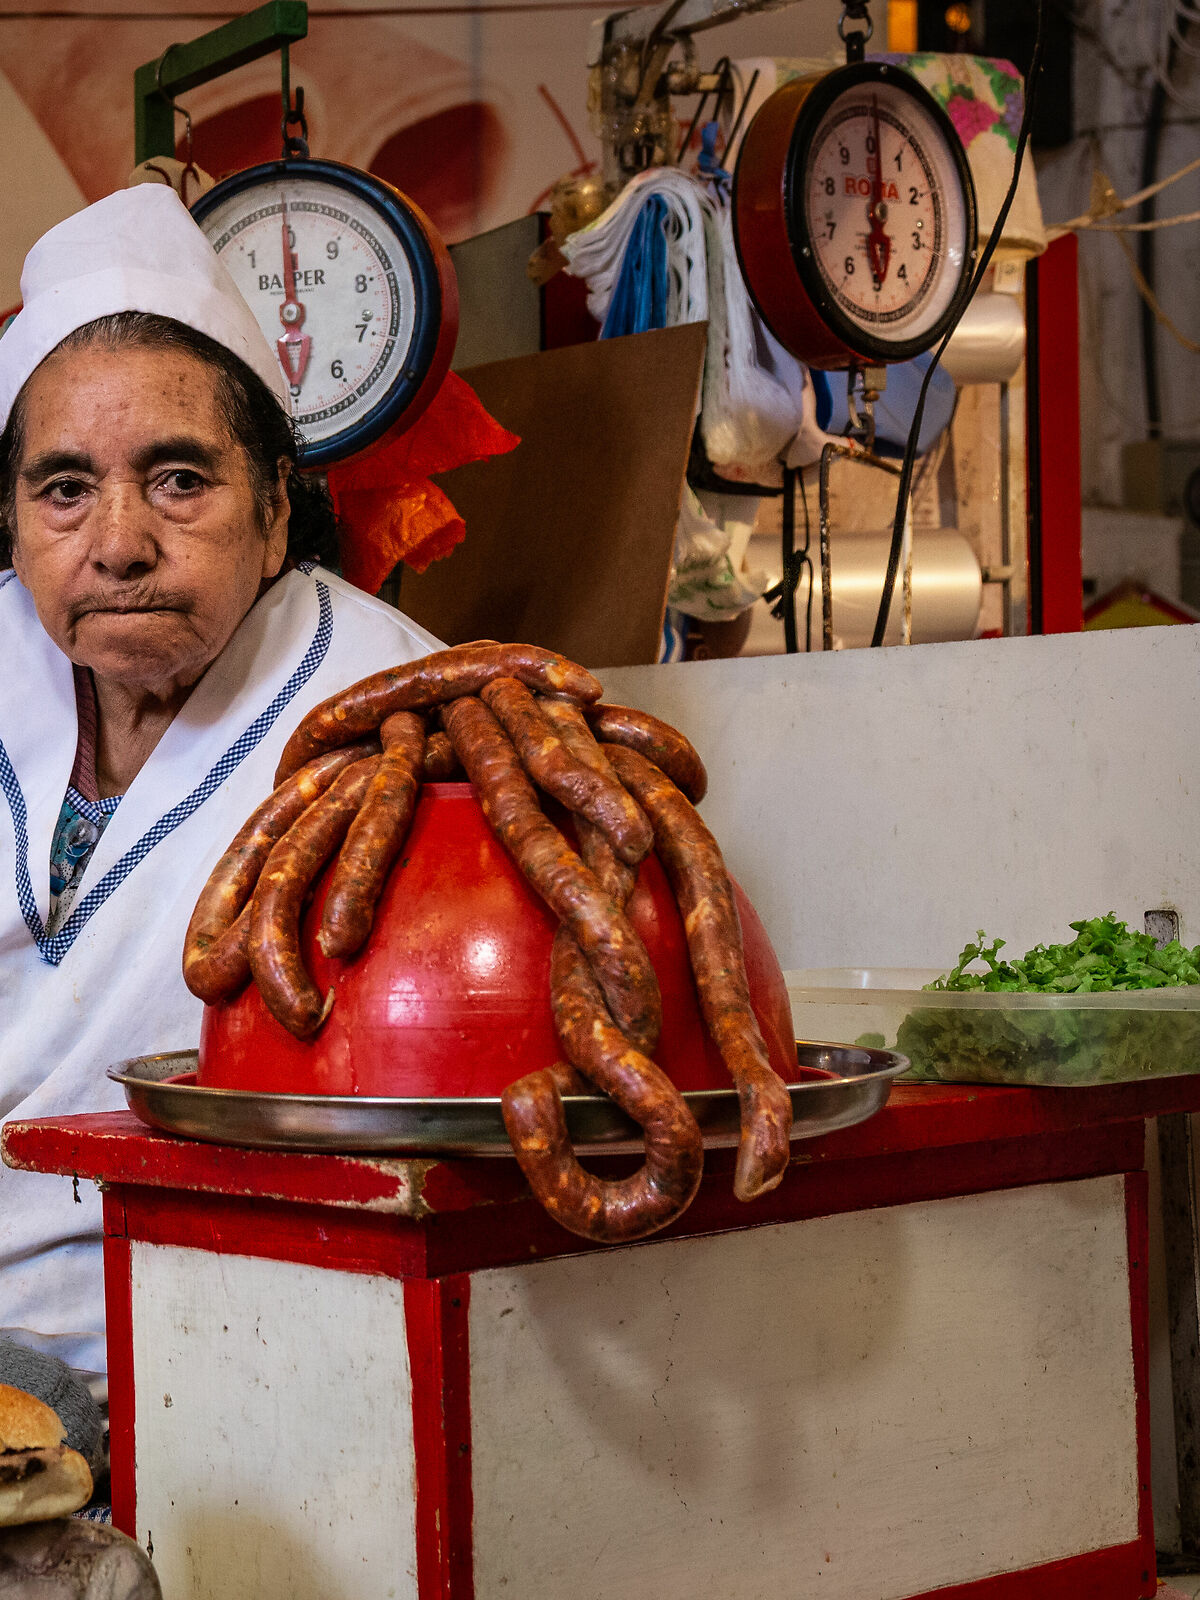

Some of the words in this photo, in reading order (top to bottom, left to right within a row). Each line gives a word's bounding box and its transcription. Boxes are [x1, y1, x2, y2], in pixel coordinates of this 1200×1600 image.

[839, 147, 850, 166] 9
[894, 154, 902, 173] 1
[825, 177, 836, 196] 8
[909, 187, 919, 206] 2
[826, 222, 837, 240] 7
[911, 231, 921, 250] 3
[247, 249, 257, 269] 1
[326, 241, 339, 260] 9
[844, 256, 855, 275] 6
[896, 263, 907, 281] 4
[258, 269, 326, 291] BAPER
[354, 274, 369, 294] 8
[354, 324, 369, 343] 7
[330, 359, 344, 379] 6
